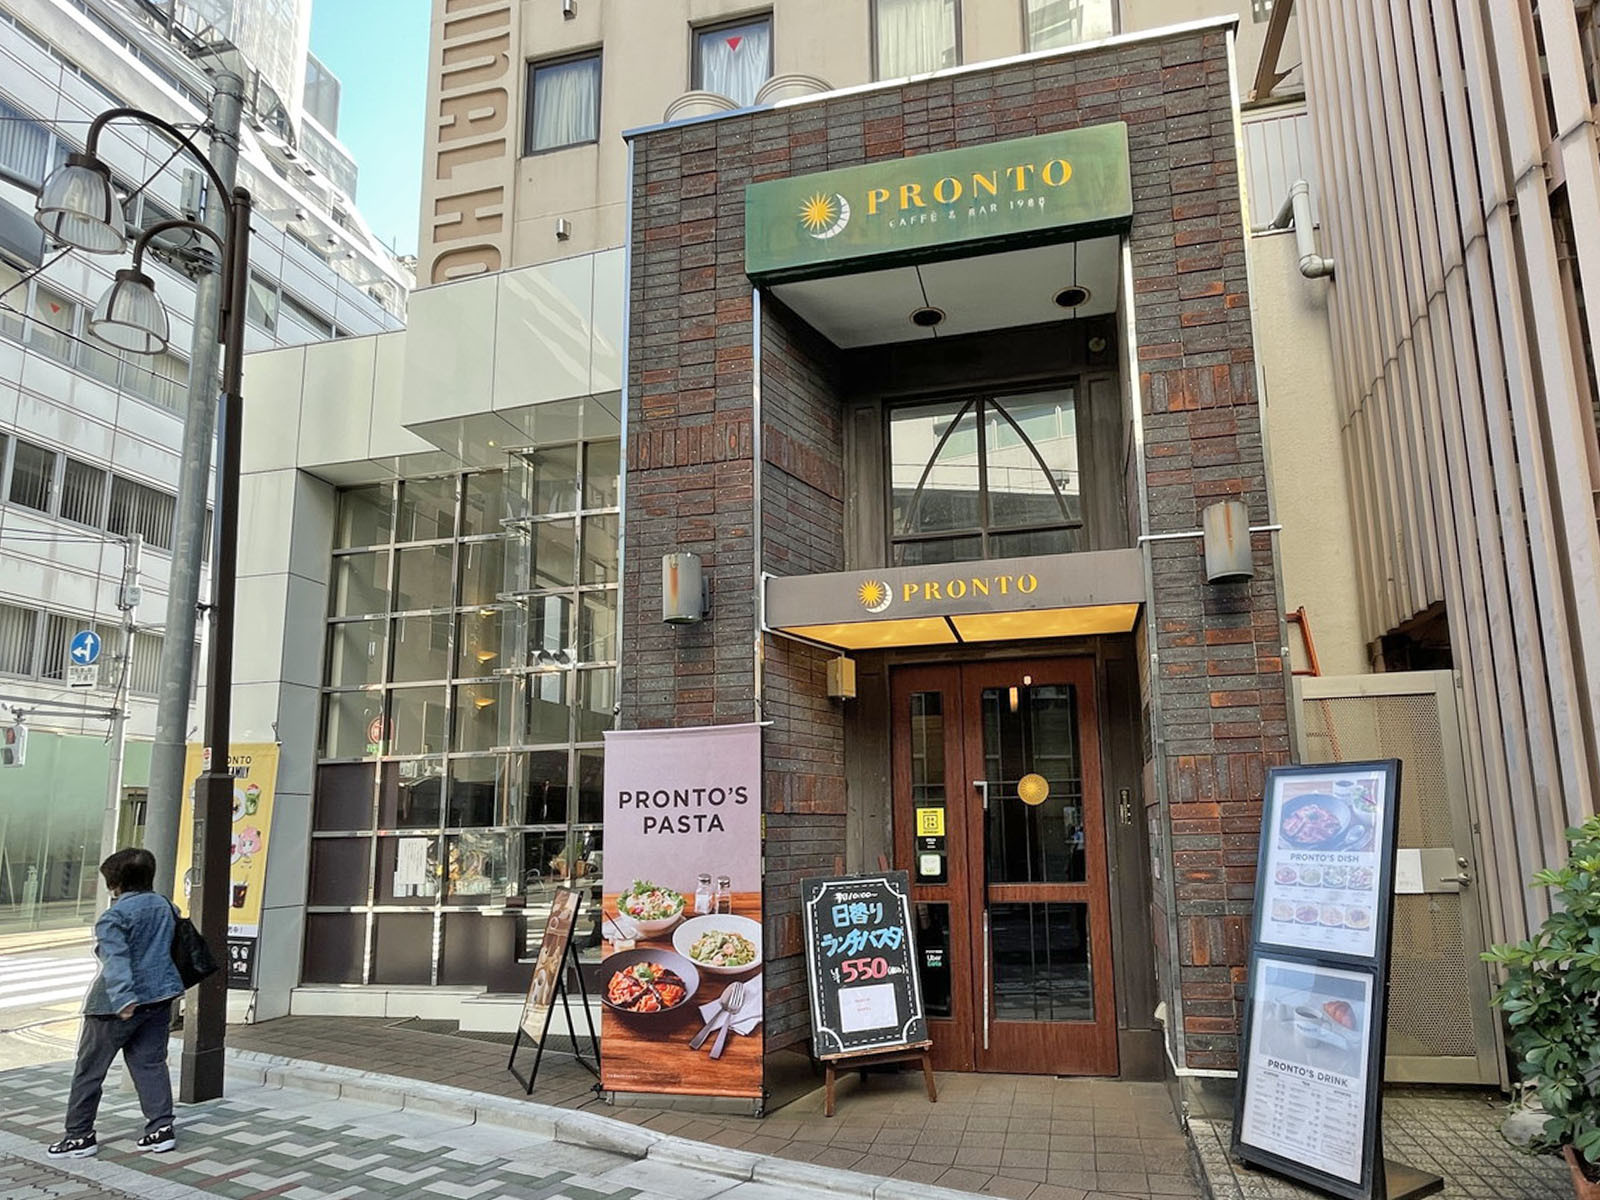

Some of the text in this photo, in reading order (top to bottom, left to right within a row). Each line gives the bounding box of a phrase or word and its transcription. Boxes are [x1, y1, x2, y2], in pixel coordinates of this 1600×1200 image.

[436, 0, 511, 181] INAL
[867, 158, 1074, 216] PRONTO
[948, 209, 957, 220] &
[968, 202, 998, 217] BAR
[902, 573, 1039, 602] PRONTO
[618, 786, 749, 809] PRONTO'S
[643, 813, 725, 835] PASTA
[1290, 852, 1360, 863] PRONTO'S DISH
[831, 901, 885, 929] 日替り
[1267, 1059, 1315, 1079] PRONTO'S
[1316, 1072, 1349, 1088] DRINK
